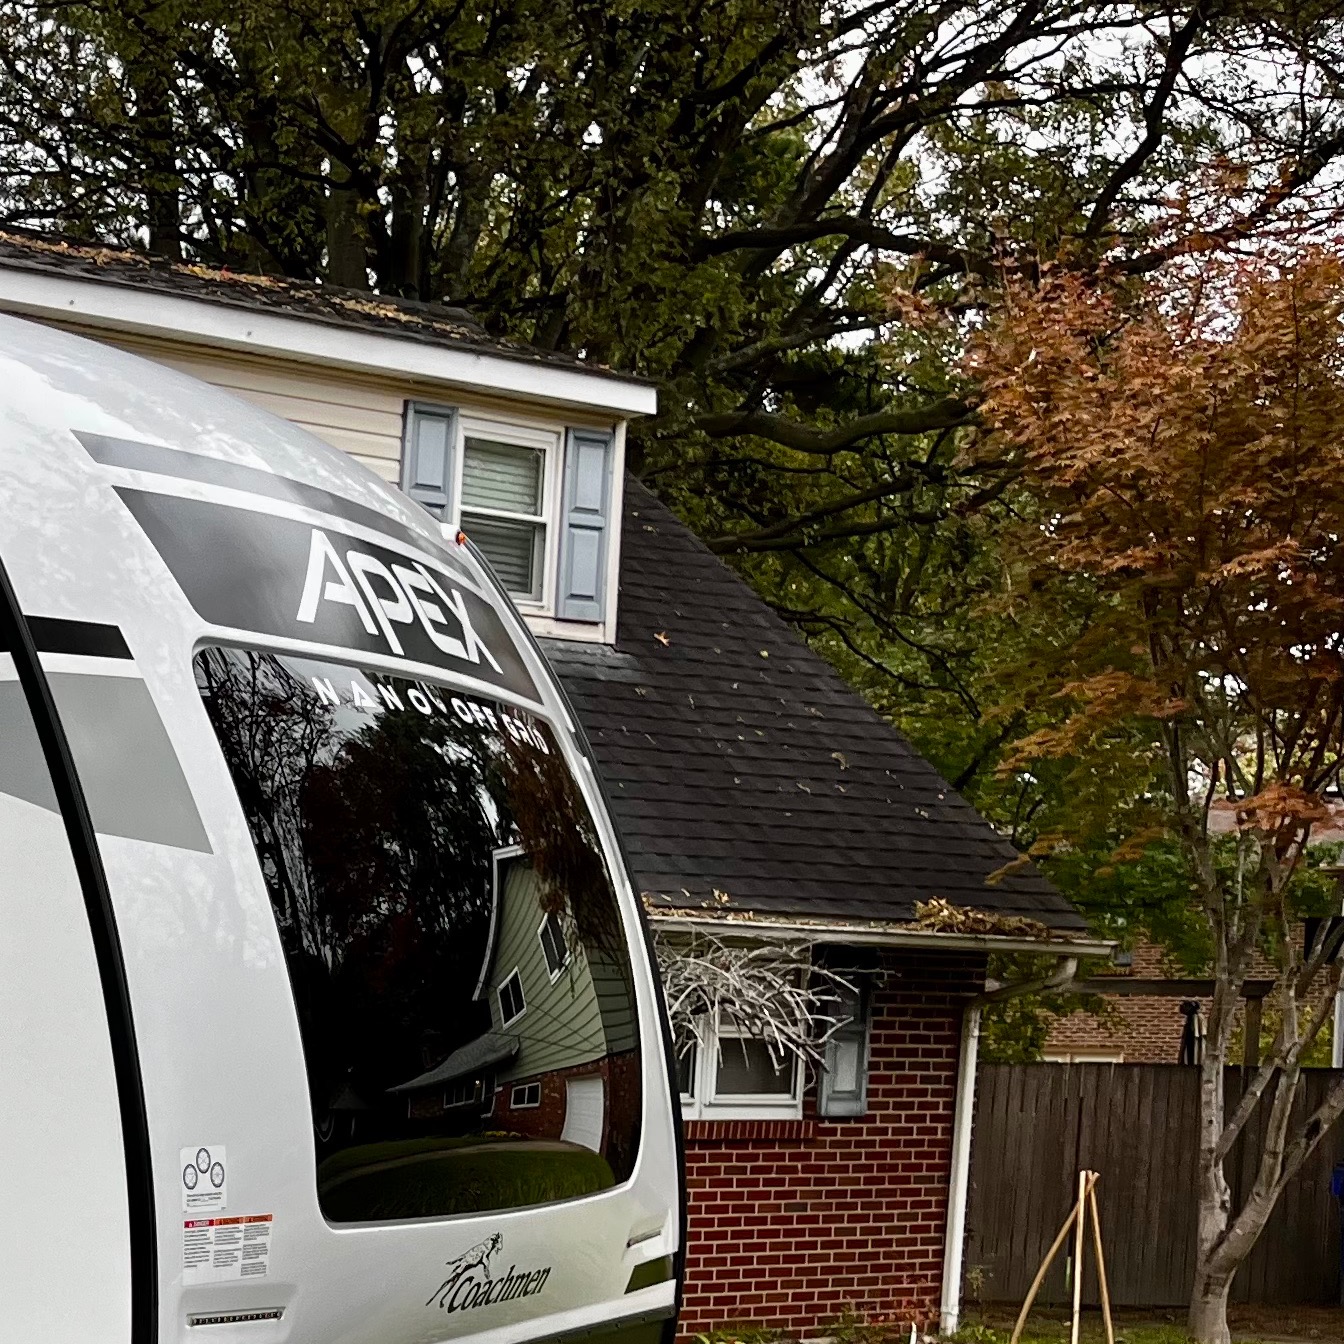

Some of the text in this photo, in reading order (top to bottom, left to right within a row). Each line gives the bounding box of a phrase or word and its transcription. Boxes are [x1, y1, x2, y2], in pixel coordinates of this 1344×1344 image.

[296, 528, 503, 674] APEX
[312, 676, 550, 755] NANO OFF GRID
[447, 1264, 552, 1314] Coachmen
